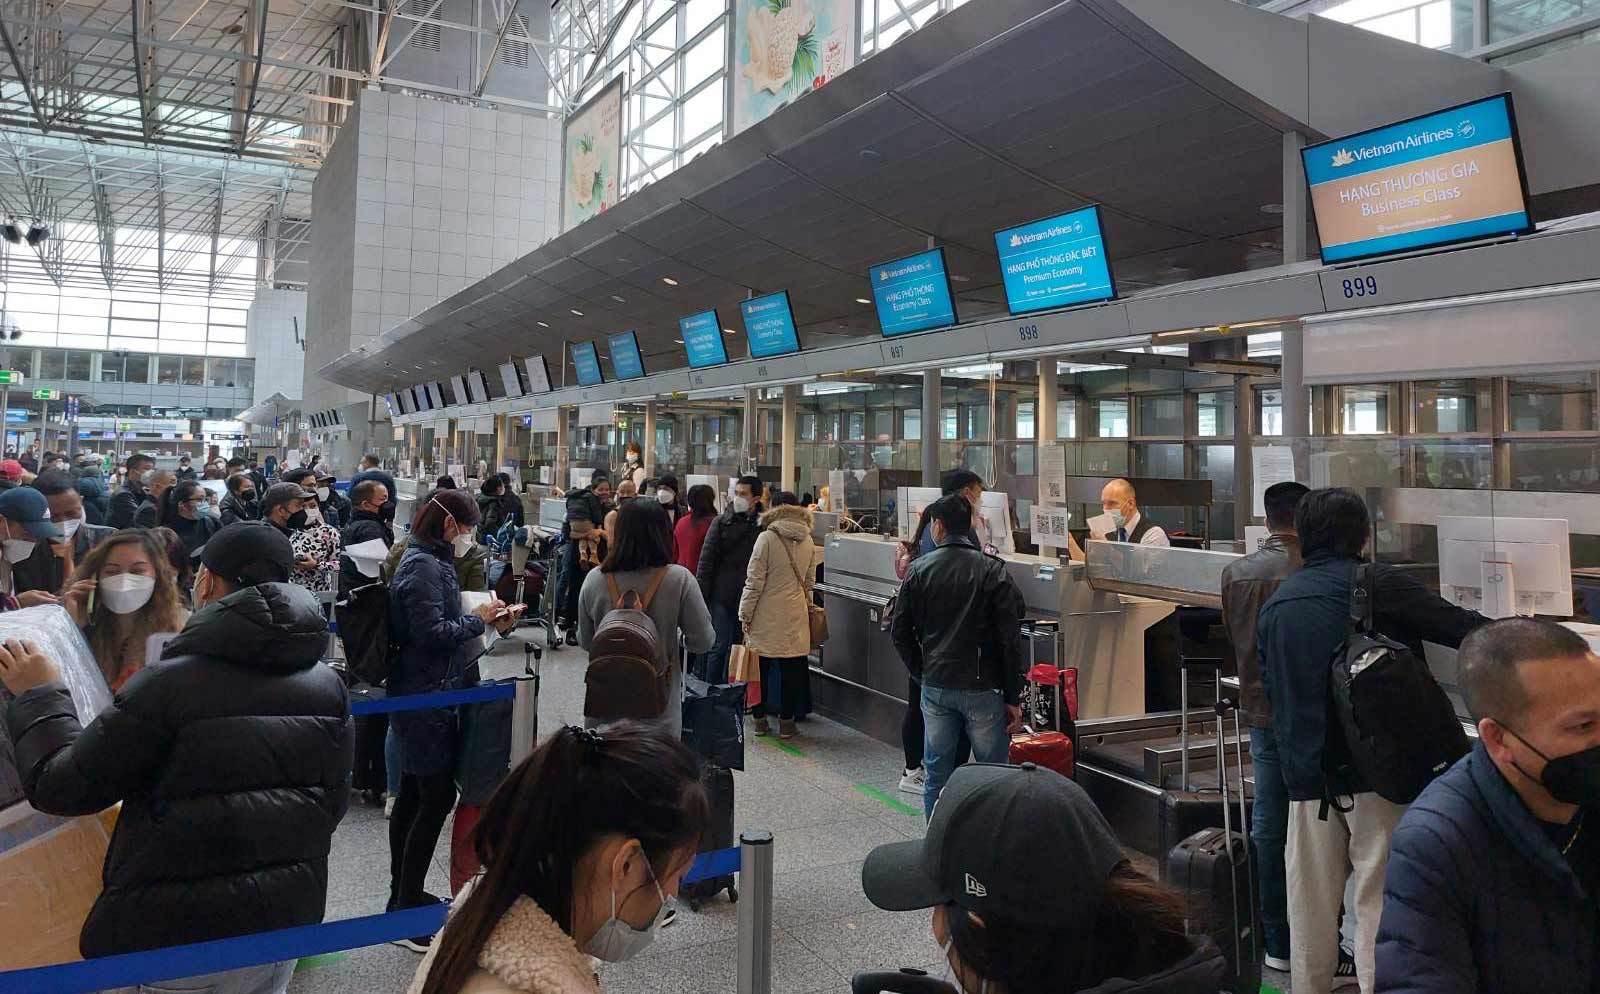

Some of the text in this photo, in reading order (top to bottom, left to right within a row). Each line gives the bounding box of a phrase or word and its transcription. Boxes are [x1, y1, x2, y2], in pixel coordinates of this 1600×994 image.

[1354, 140, 1405, 161] Vietnam
[1405, 127, 1454, 149] Airlines
[1451, 160, 1480, 178] GIA
[1361, 186, 1461, 217] Business Class
[1023, 266, 1083, 284] Premium Economy
[1342, 275, 1377, 298] 899
[1019, 324, 1038, 340] 898
[890, 345, 904, 358] 897
